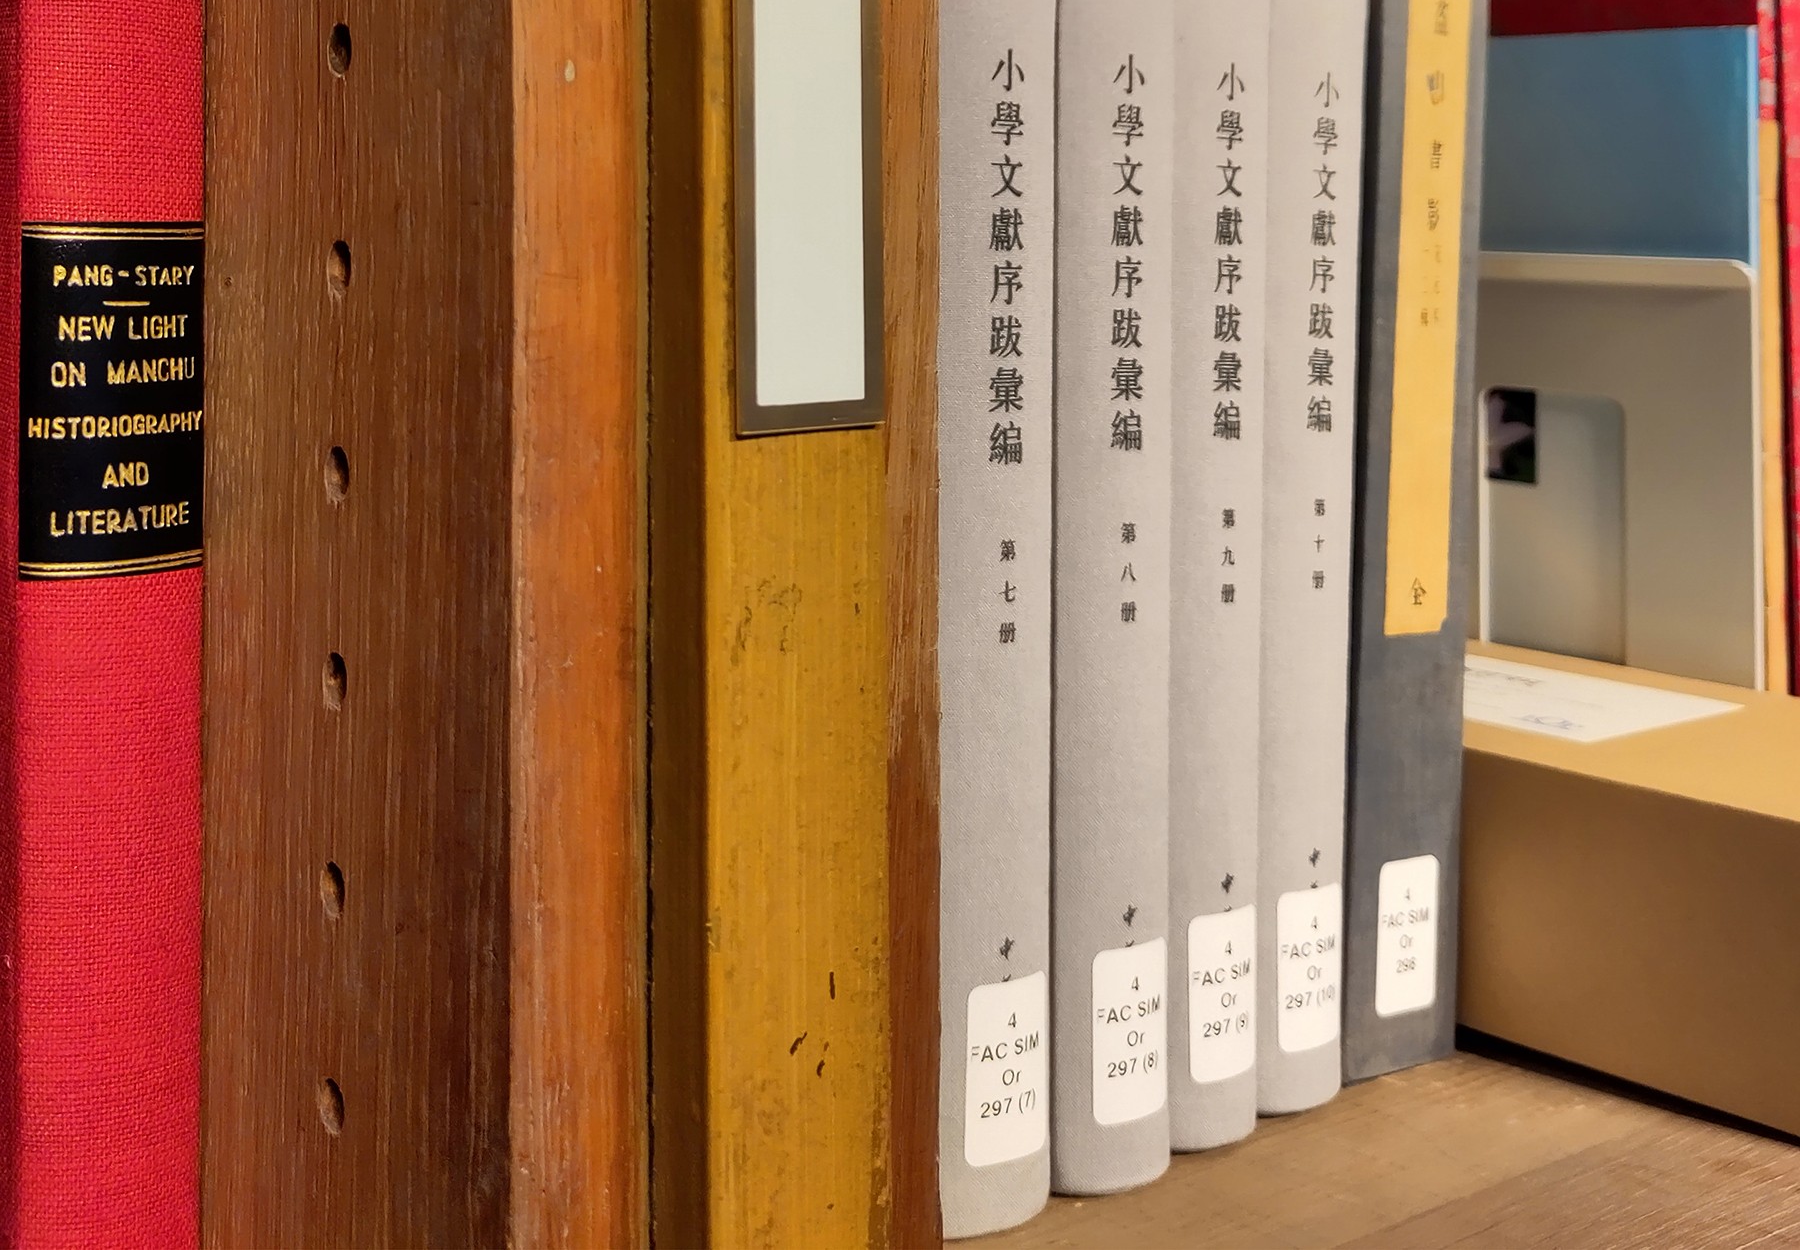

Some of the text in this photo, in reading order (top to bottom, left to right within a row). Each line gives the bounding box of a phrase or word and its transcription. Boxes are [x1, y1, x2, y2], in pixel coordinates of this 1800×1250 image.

[58, 314, 188, 342] NEW LIGHT
[50, 357, 195, 388] ON MANCHU
[28, 410, 203, 440] HISTORIOGRAPHY
[102, 462, 149, 489] AND
[50, 501, 189, 538] LITERATURE
[1311, 916, 1318, 929] 4
[1224, 940, 1232, 955] 4
[1131, 976, 1139, 991] 4
[1193, 957, 1250, 986] FAC SIM
[1307, 965, 1322, 980] Or
[1097, 994, 1160, 1024] FAC SIM
[1221, 992, 1237, 1008] Or
[1285, 992, 1312, 1009] 297
[1008, 1012, 1017, 1028] 4
[1203, 1012, 1249, 1038] 297 (9)
[971, 1030, 1039, 1063] FAC SIM
[1127, 1030, 1145, 1047] Or
[1107, 1050, 1158, 1078] 297 (8)
[1002, 1069, 1022, 1086] Or
[980, 1088, 1036, 1118] 297 (7)
